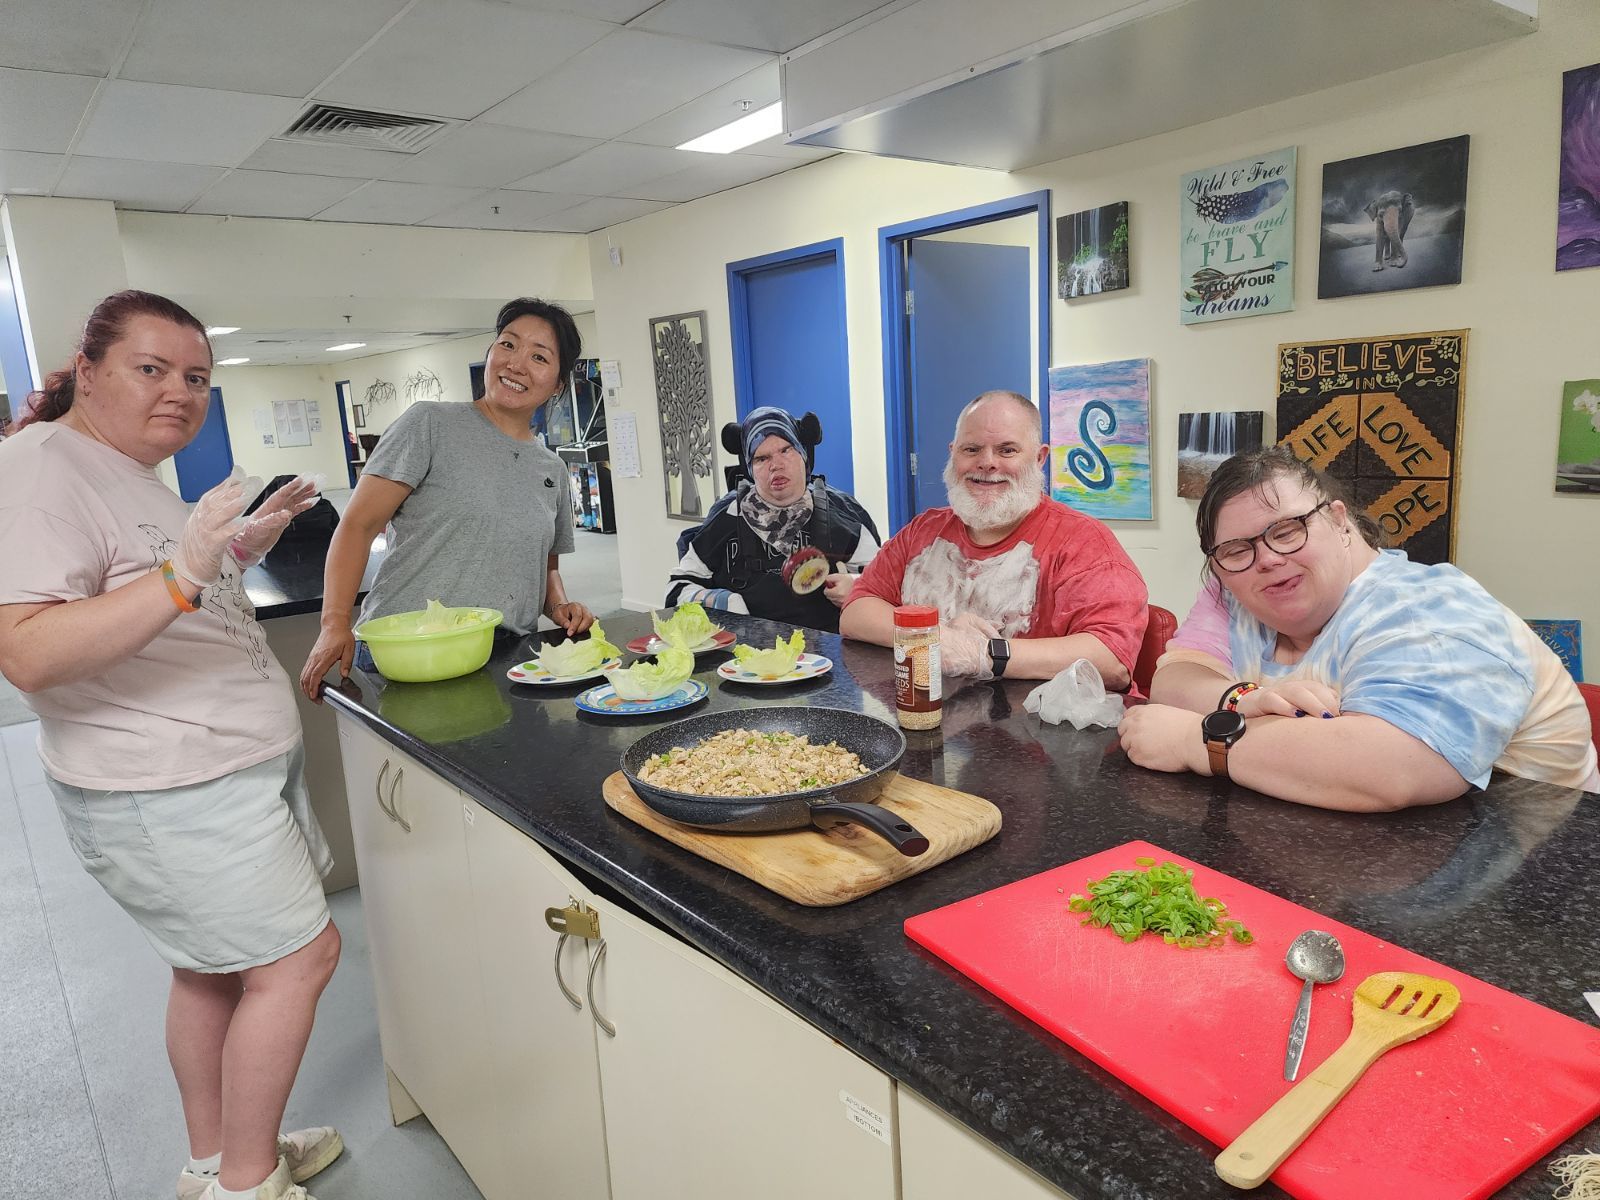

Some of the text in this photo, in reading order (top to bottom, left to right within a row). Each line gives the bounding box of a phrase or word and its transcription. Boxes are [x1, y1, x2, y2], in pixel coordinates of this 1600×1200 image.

[1187, 172, 1226, 197] Wild
[1247, 161, 1288, 182] Free
[1186, 208, 1288, 245] be brave and
[1200, 230, 1272, 268] FLY
[1239, 273, 1275, 289] YOUR
[1184, 294, 1274, 316] dreams
[1297, 341, 1437, 381] BELIEVE
[1355, 376, 1376, 390] IN
[1303, 411, 1352, 464] IFE
[1364, 405, 1433, 475] LOVE
[1379, 483, 1441, 535] OPE
[855, 1115, 882, 1136] BOTTOM
